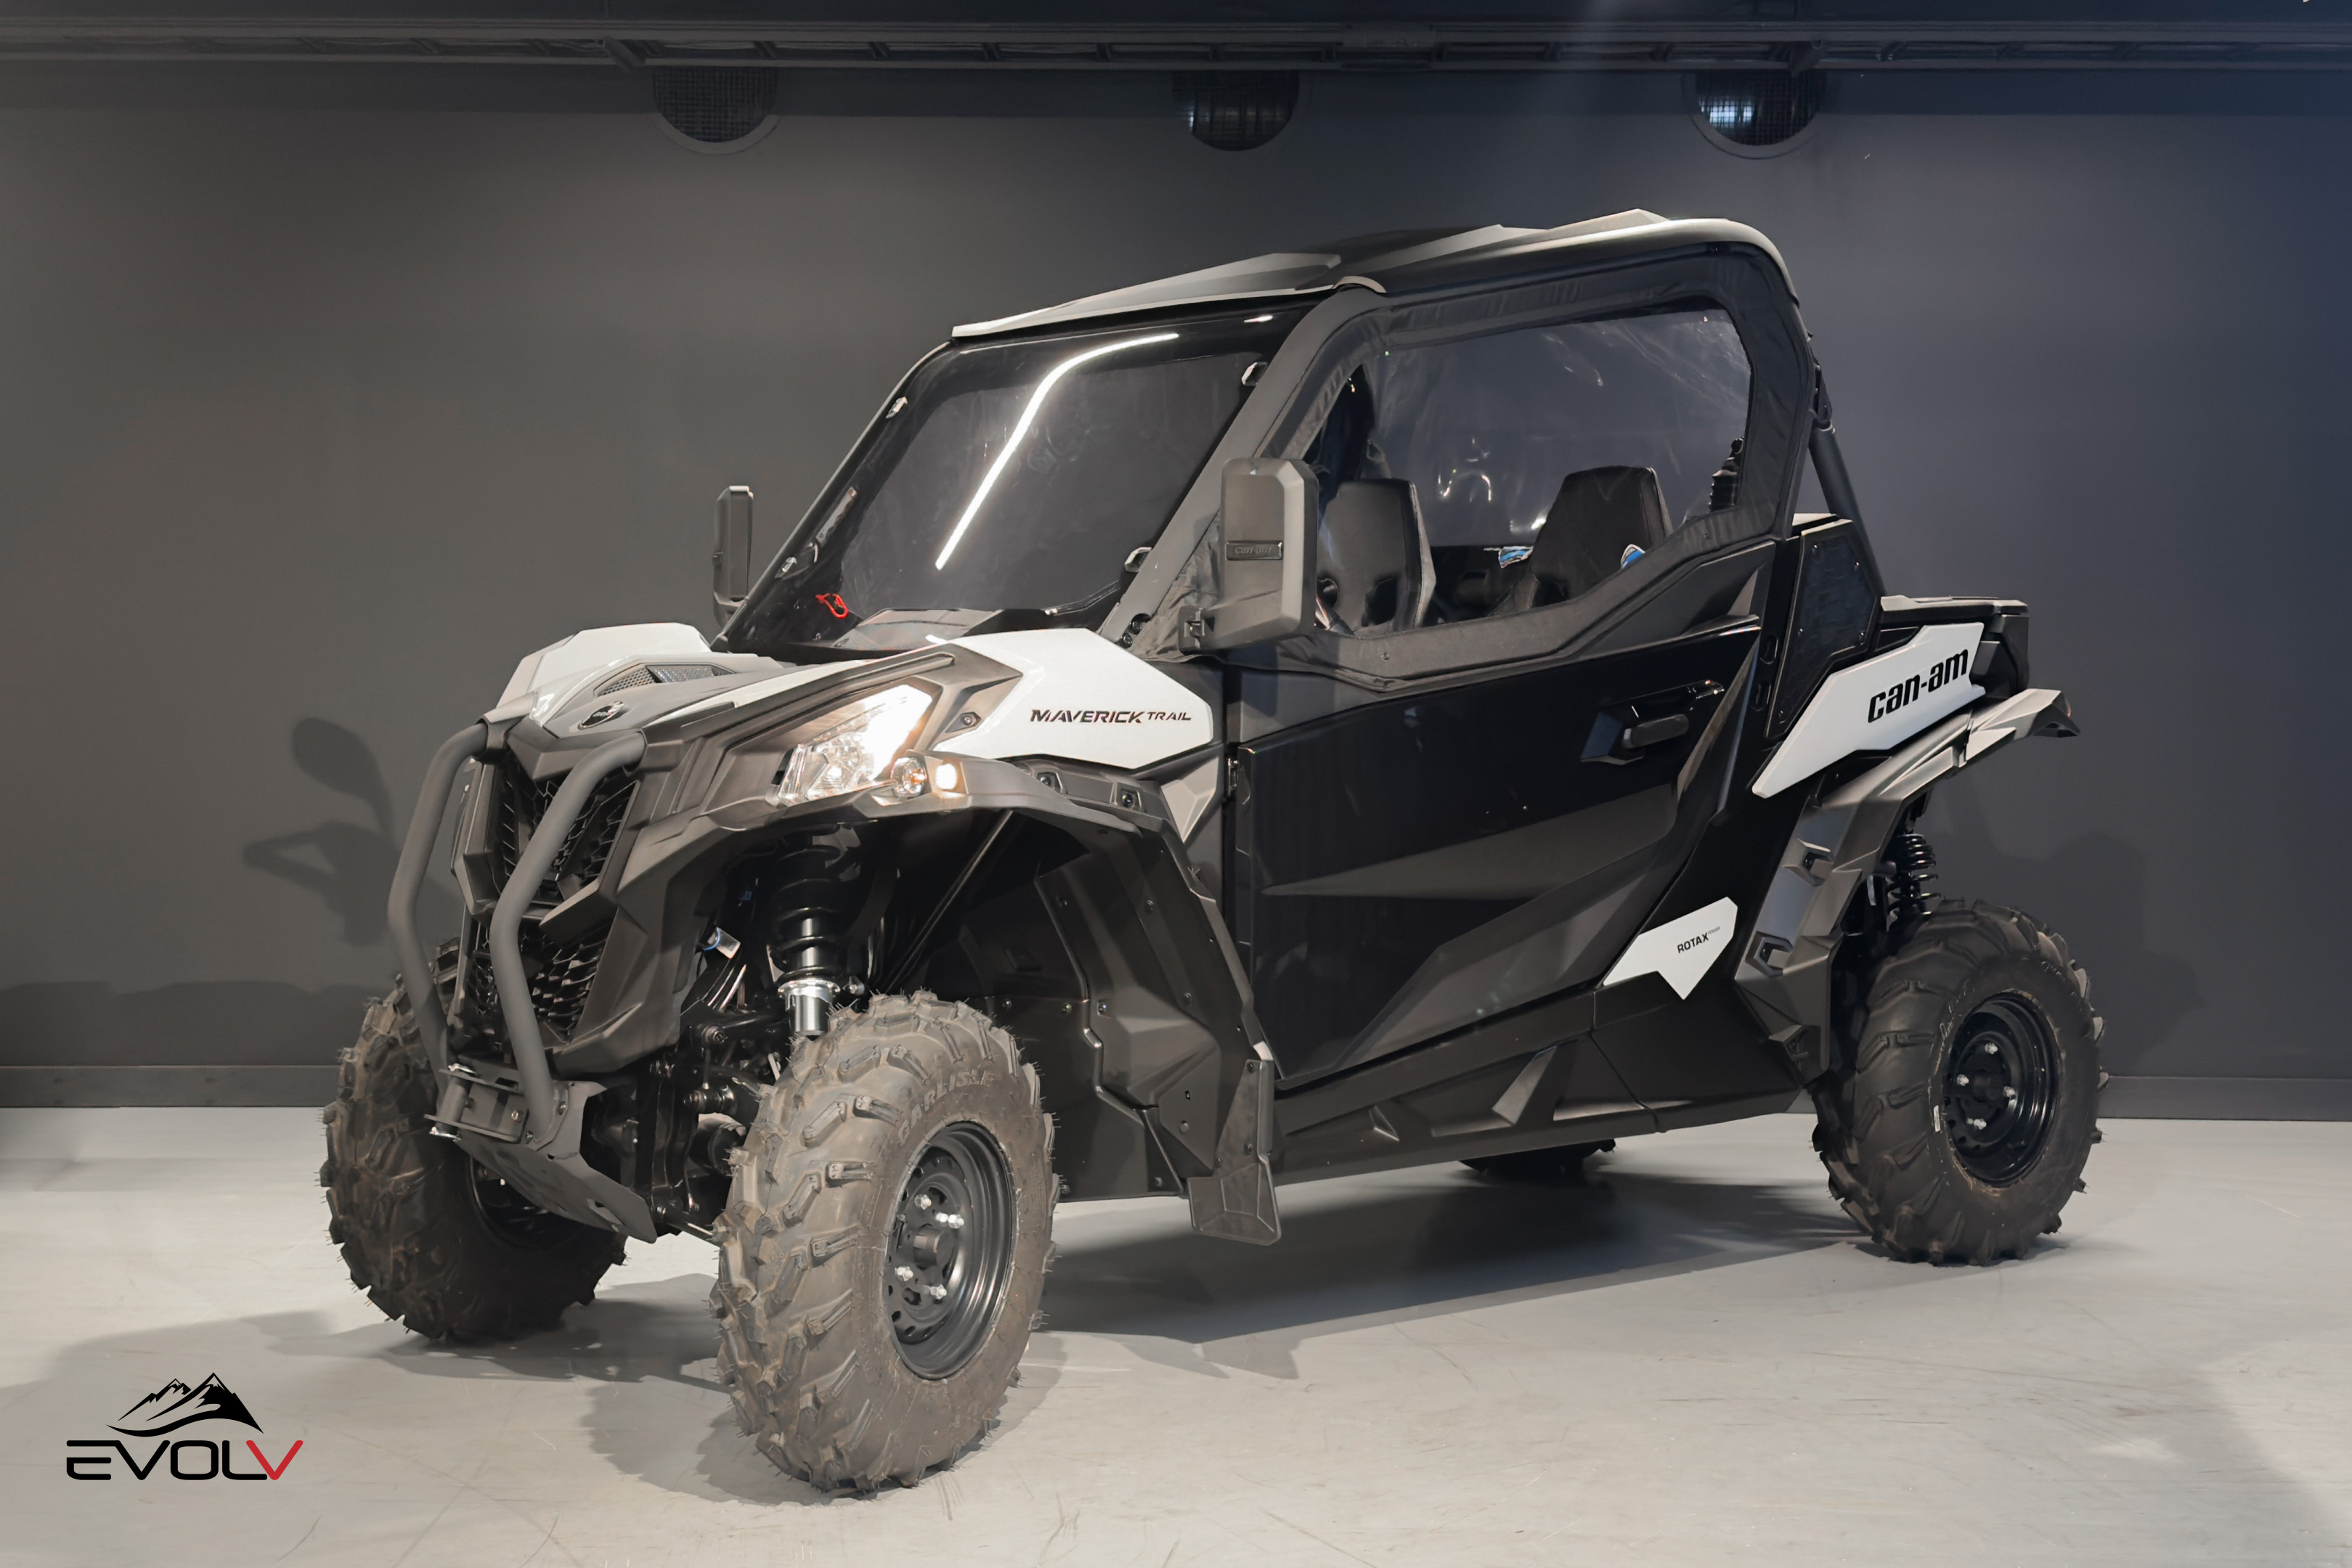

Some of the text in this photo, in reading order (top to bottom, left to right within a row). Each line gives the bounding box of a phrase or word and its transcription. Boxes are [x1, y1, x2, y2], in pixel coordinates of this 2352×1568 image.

[1868, 648, 1969, 724] can-am
[1030, 709, 1192, 724] MAVERICK TRAIL
[1677, 932, 1709, 954] ROTAX
